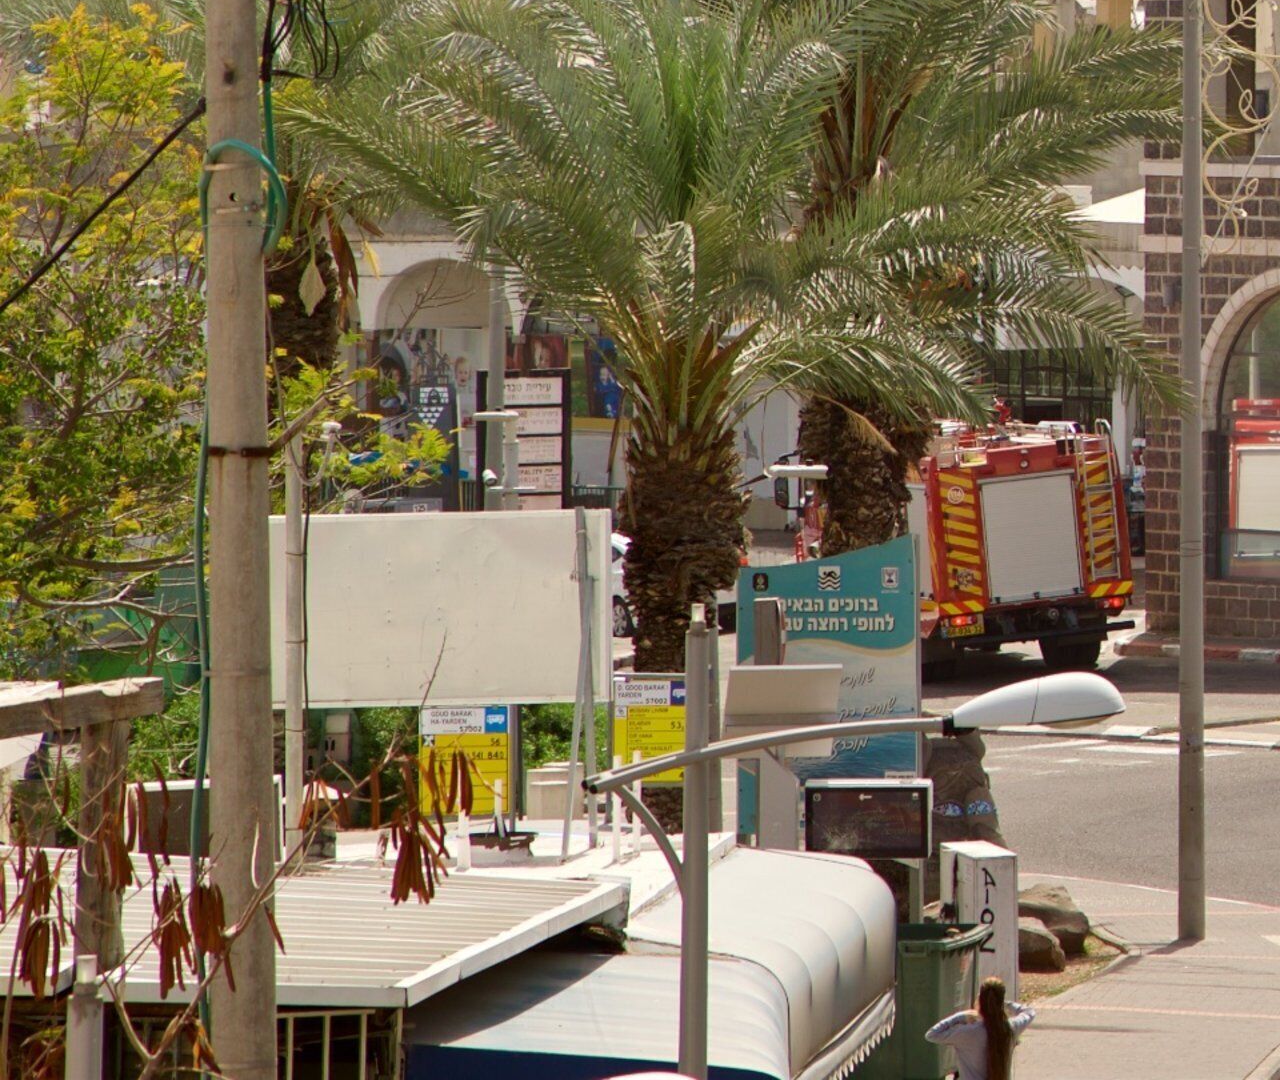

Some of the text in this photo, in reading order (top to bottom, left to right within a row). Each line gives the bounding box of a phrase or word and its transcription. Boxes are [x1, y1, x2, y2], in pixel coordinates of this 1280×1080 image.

[503, 382, 522, 392] טברי
[828, 598, 878, 613] ברוכים
[807, 617, 849, 632] רחצה
[852, 613, 895, 632] לחופי
